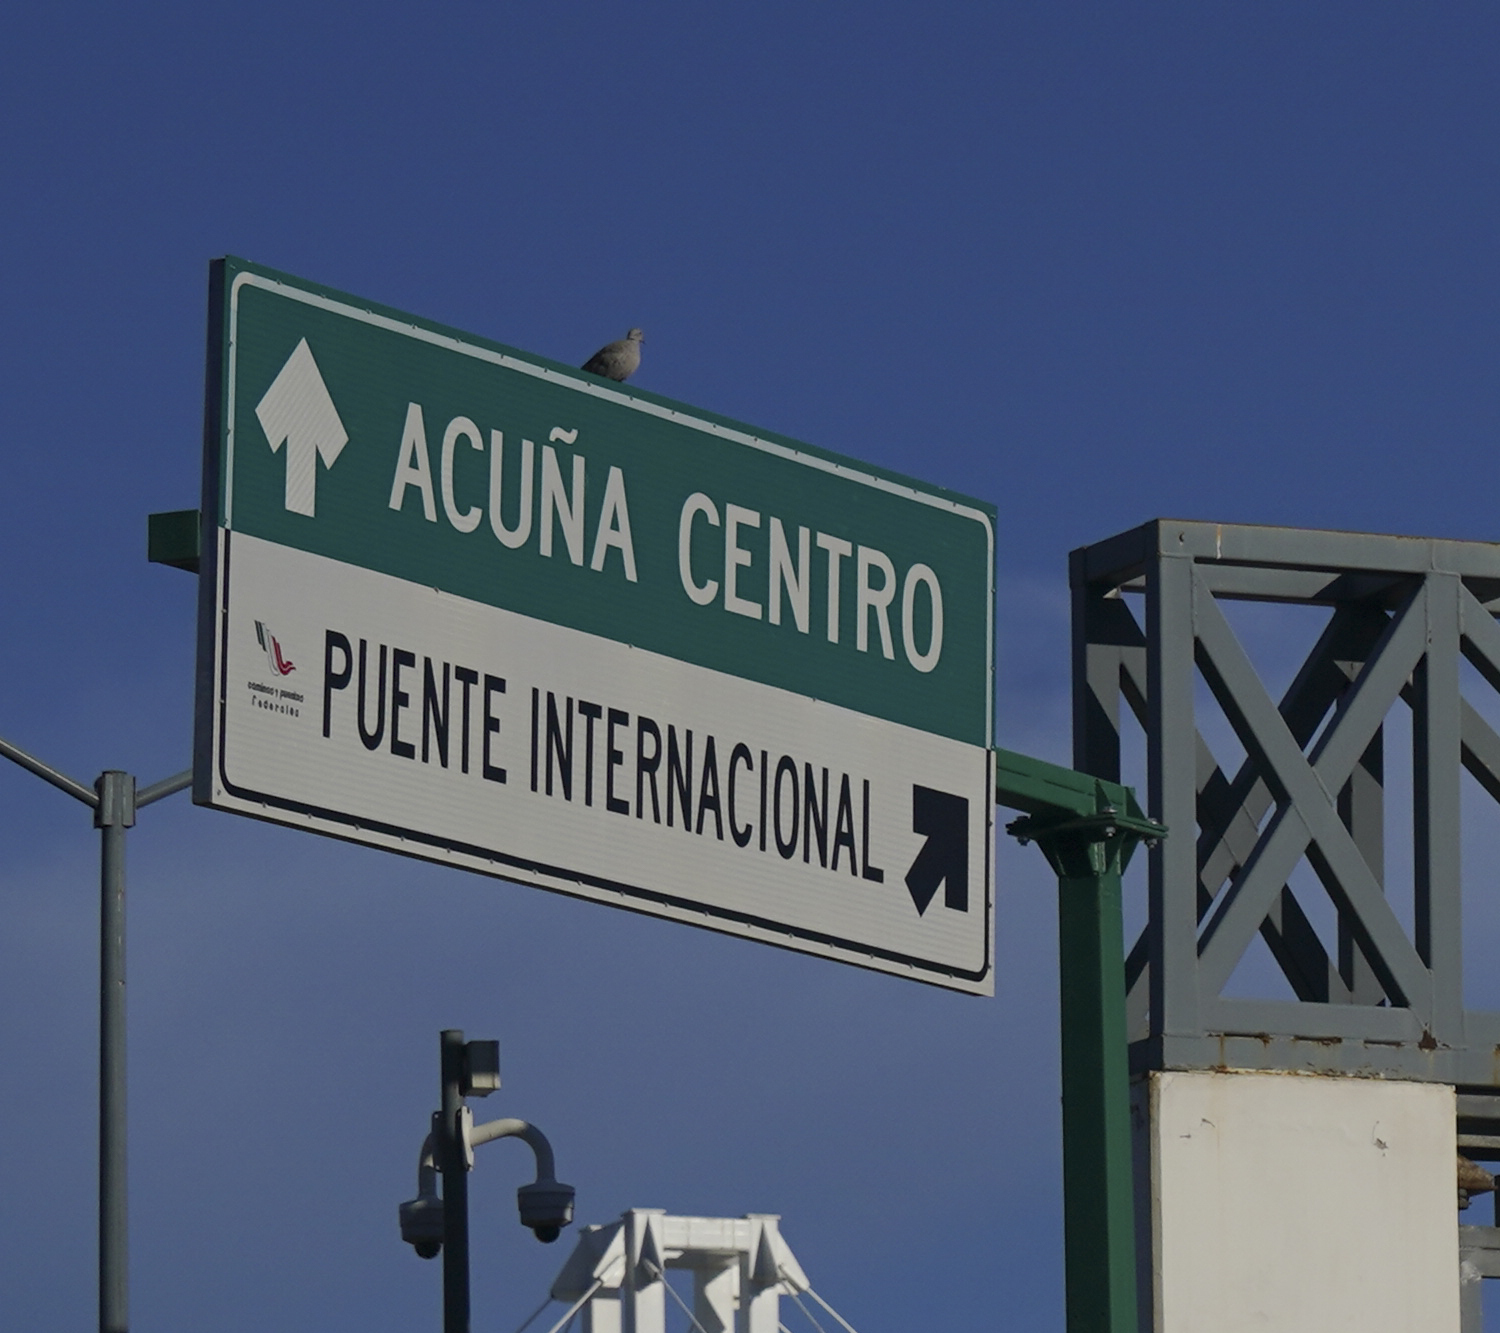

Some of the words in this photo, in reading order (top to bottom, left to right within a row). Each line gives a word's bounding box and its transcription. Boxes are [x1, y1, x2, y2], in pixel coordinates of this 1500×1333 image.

[389, 402, 638, 583] ACUÑA
[678, 492, 945, 673] CENTRO
[322, 629, 507, 785] PUENTE
[530, 687, 885, 884] INTERNACIONAL
